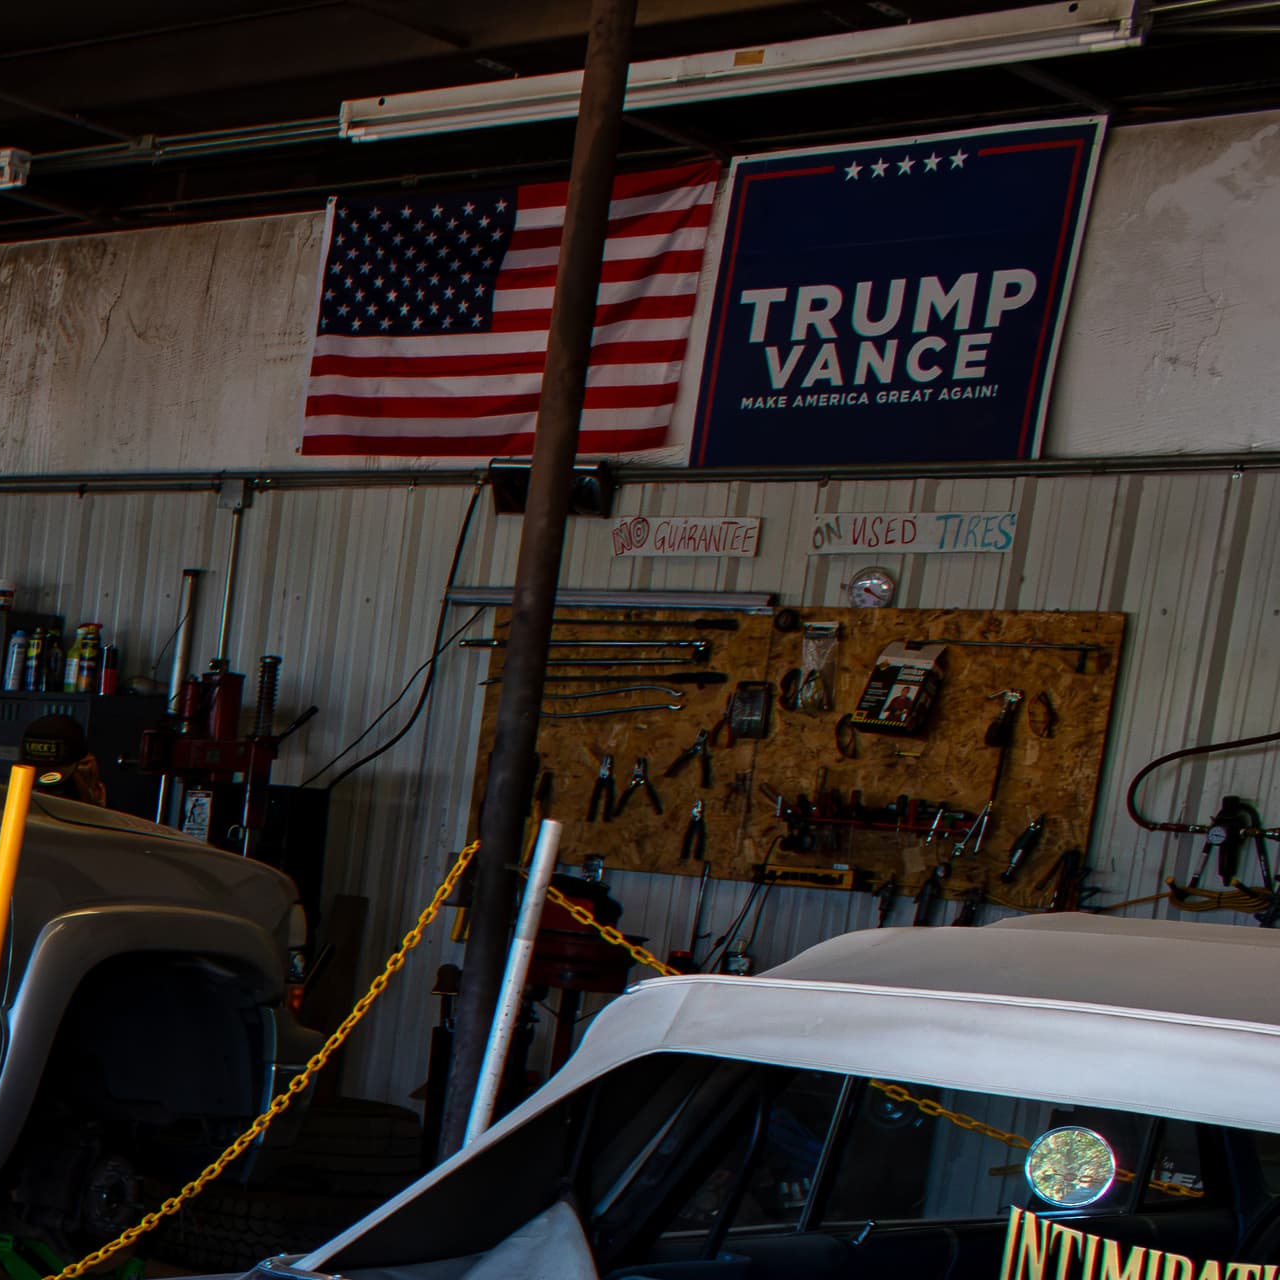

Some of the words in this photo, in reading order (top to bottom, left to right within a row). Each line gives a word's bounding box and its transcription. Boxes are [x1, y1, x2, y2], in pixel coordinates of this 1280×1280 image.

[740, 267, 1039, 344] TRUMP
[764, 332, 993, 390] VANCE
[739, 394, 788, 411] MAKE
[791, 391, 871, 408] AMERICA
[875, 387, 934, 405] GREAT
[937, 383, 1000, 402] AGAIN!
[612, 517, 651, 556] NO
[653, 519, 755, 554] GUARANTEE
[812, 518, 843, 551] ON
[851, 516, 917, 548] USED
[935, 513, 1017, 551] TIRES
